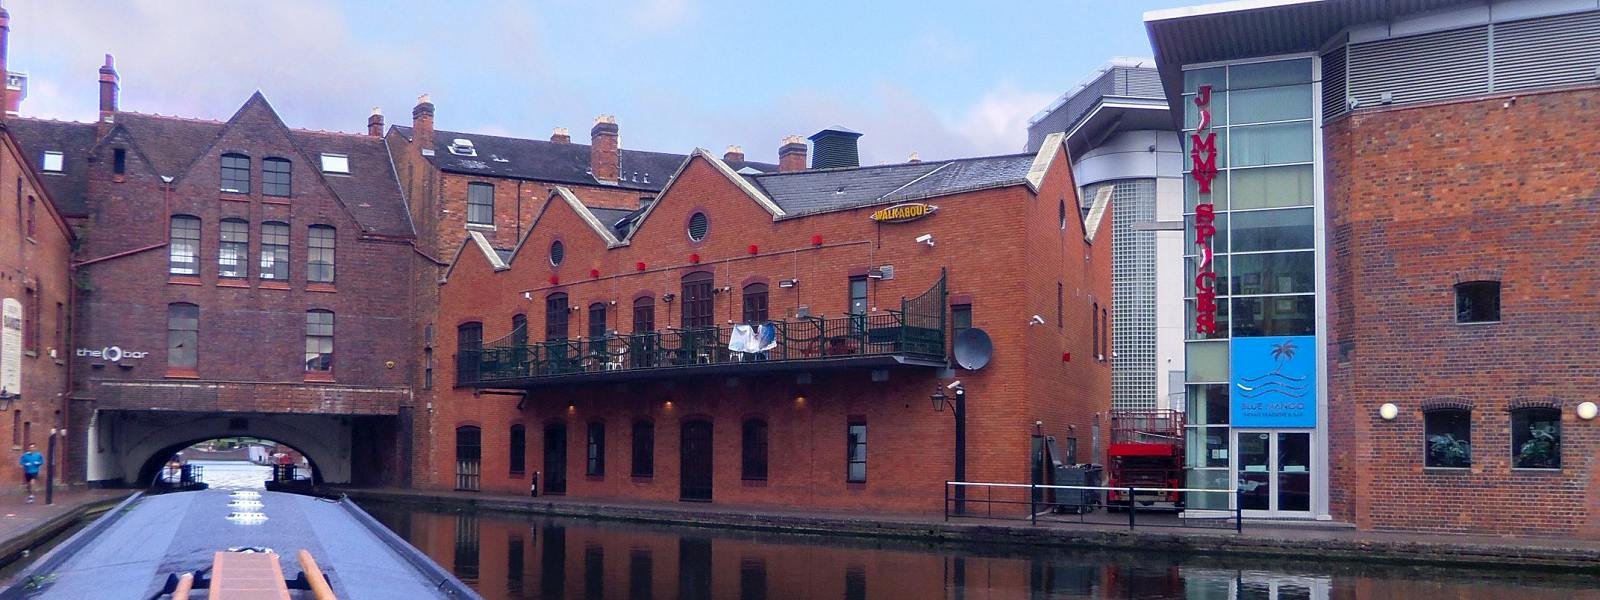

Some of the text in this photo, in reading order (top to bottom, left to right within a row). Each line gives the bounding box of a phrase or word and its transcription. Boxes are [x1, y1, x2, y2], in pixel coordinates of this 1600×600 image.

[875, 204, 929, 220] WALKABOUT
[77, 348, 101, 356] the
[123, 350, 149, 358] bar
